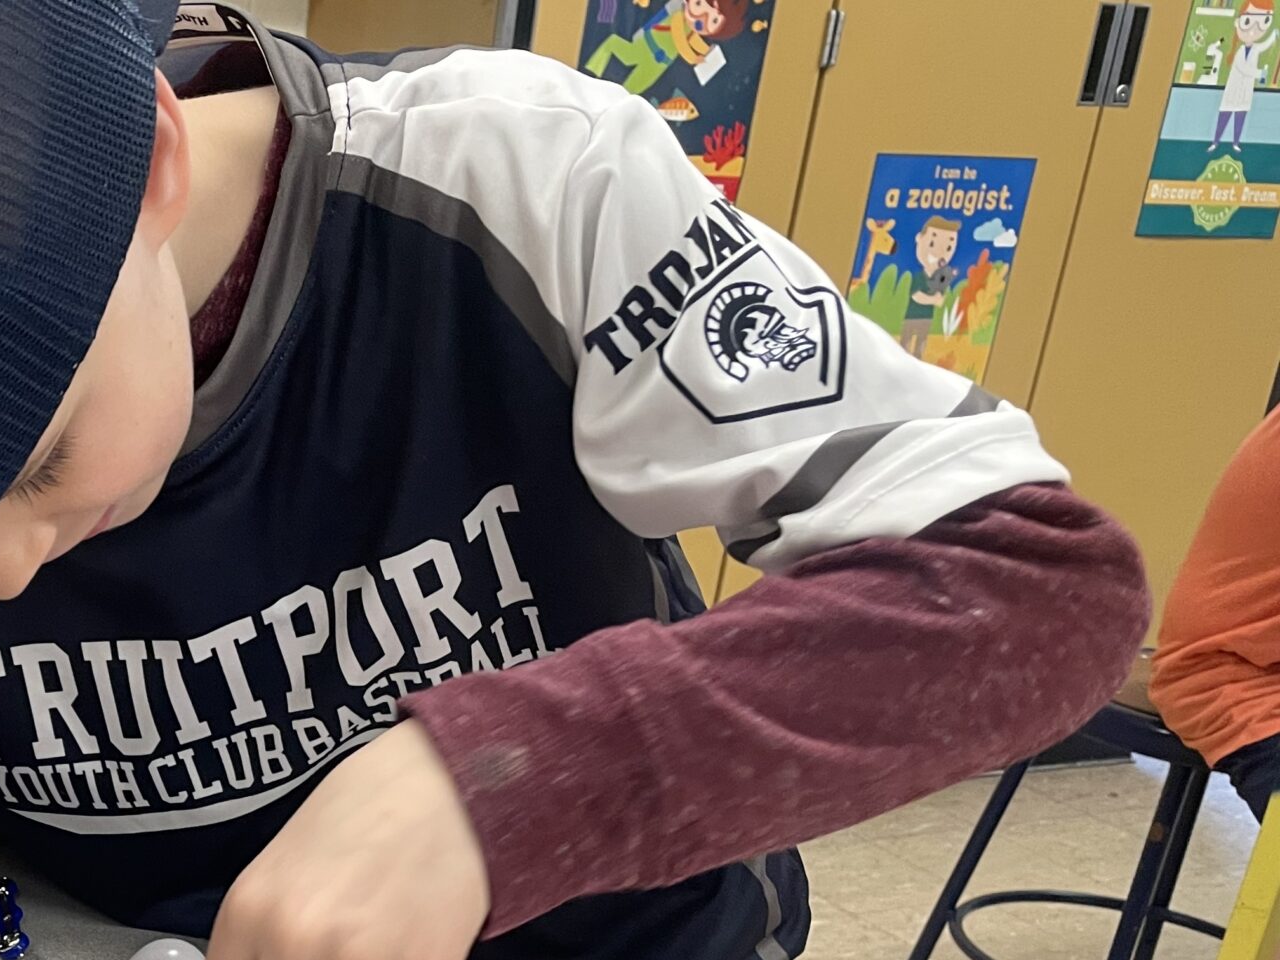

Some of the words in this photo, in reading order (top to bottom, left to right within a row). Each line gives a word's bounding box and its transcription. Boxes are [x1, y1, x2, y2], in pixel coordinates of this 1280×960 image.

[175, 13, 209, 26] OUTH
[934, 164, 941, 179] I
[942, 168, 961, 179] can
[963, 166, 978, 180] be
[885, 188, 901, 208] a
[906, 182, 1013, 216] zoologist.
[1150, 183, 1205, 201] Discover.
[1210, 184, 1237, 201] Test.
[149, 723, 293, 804] CLUB
